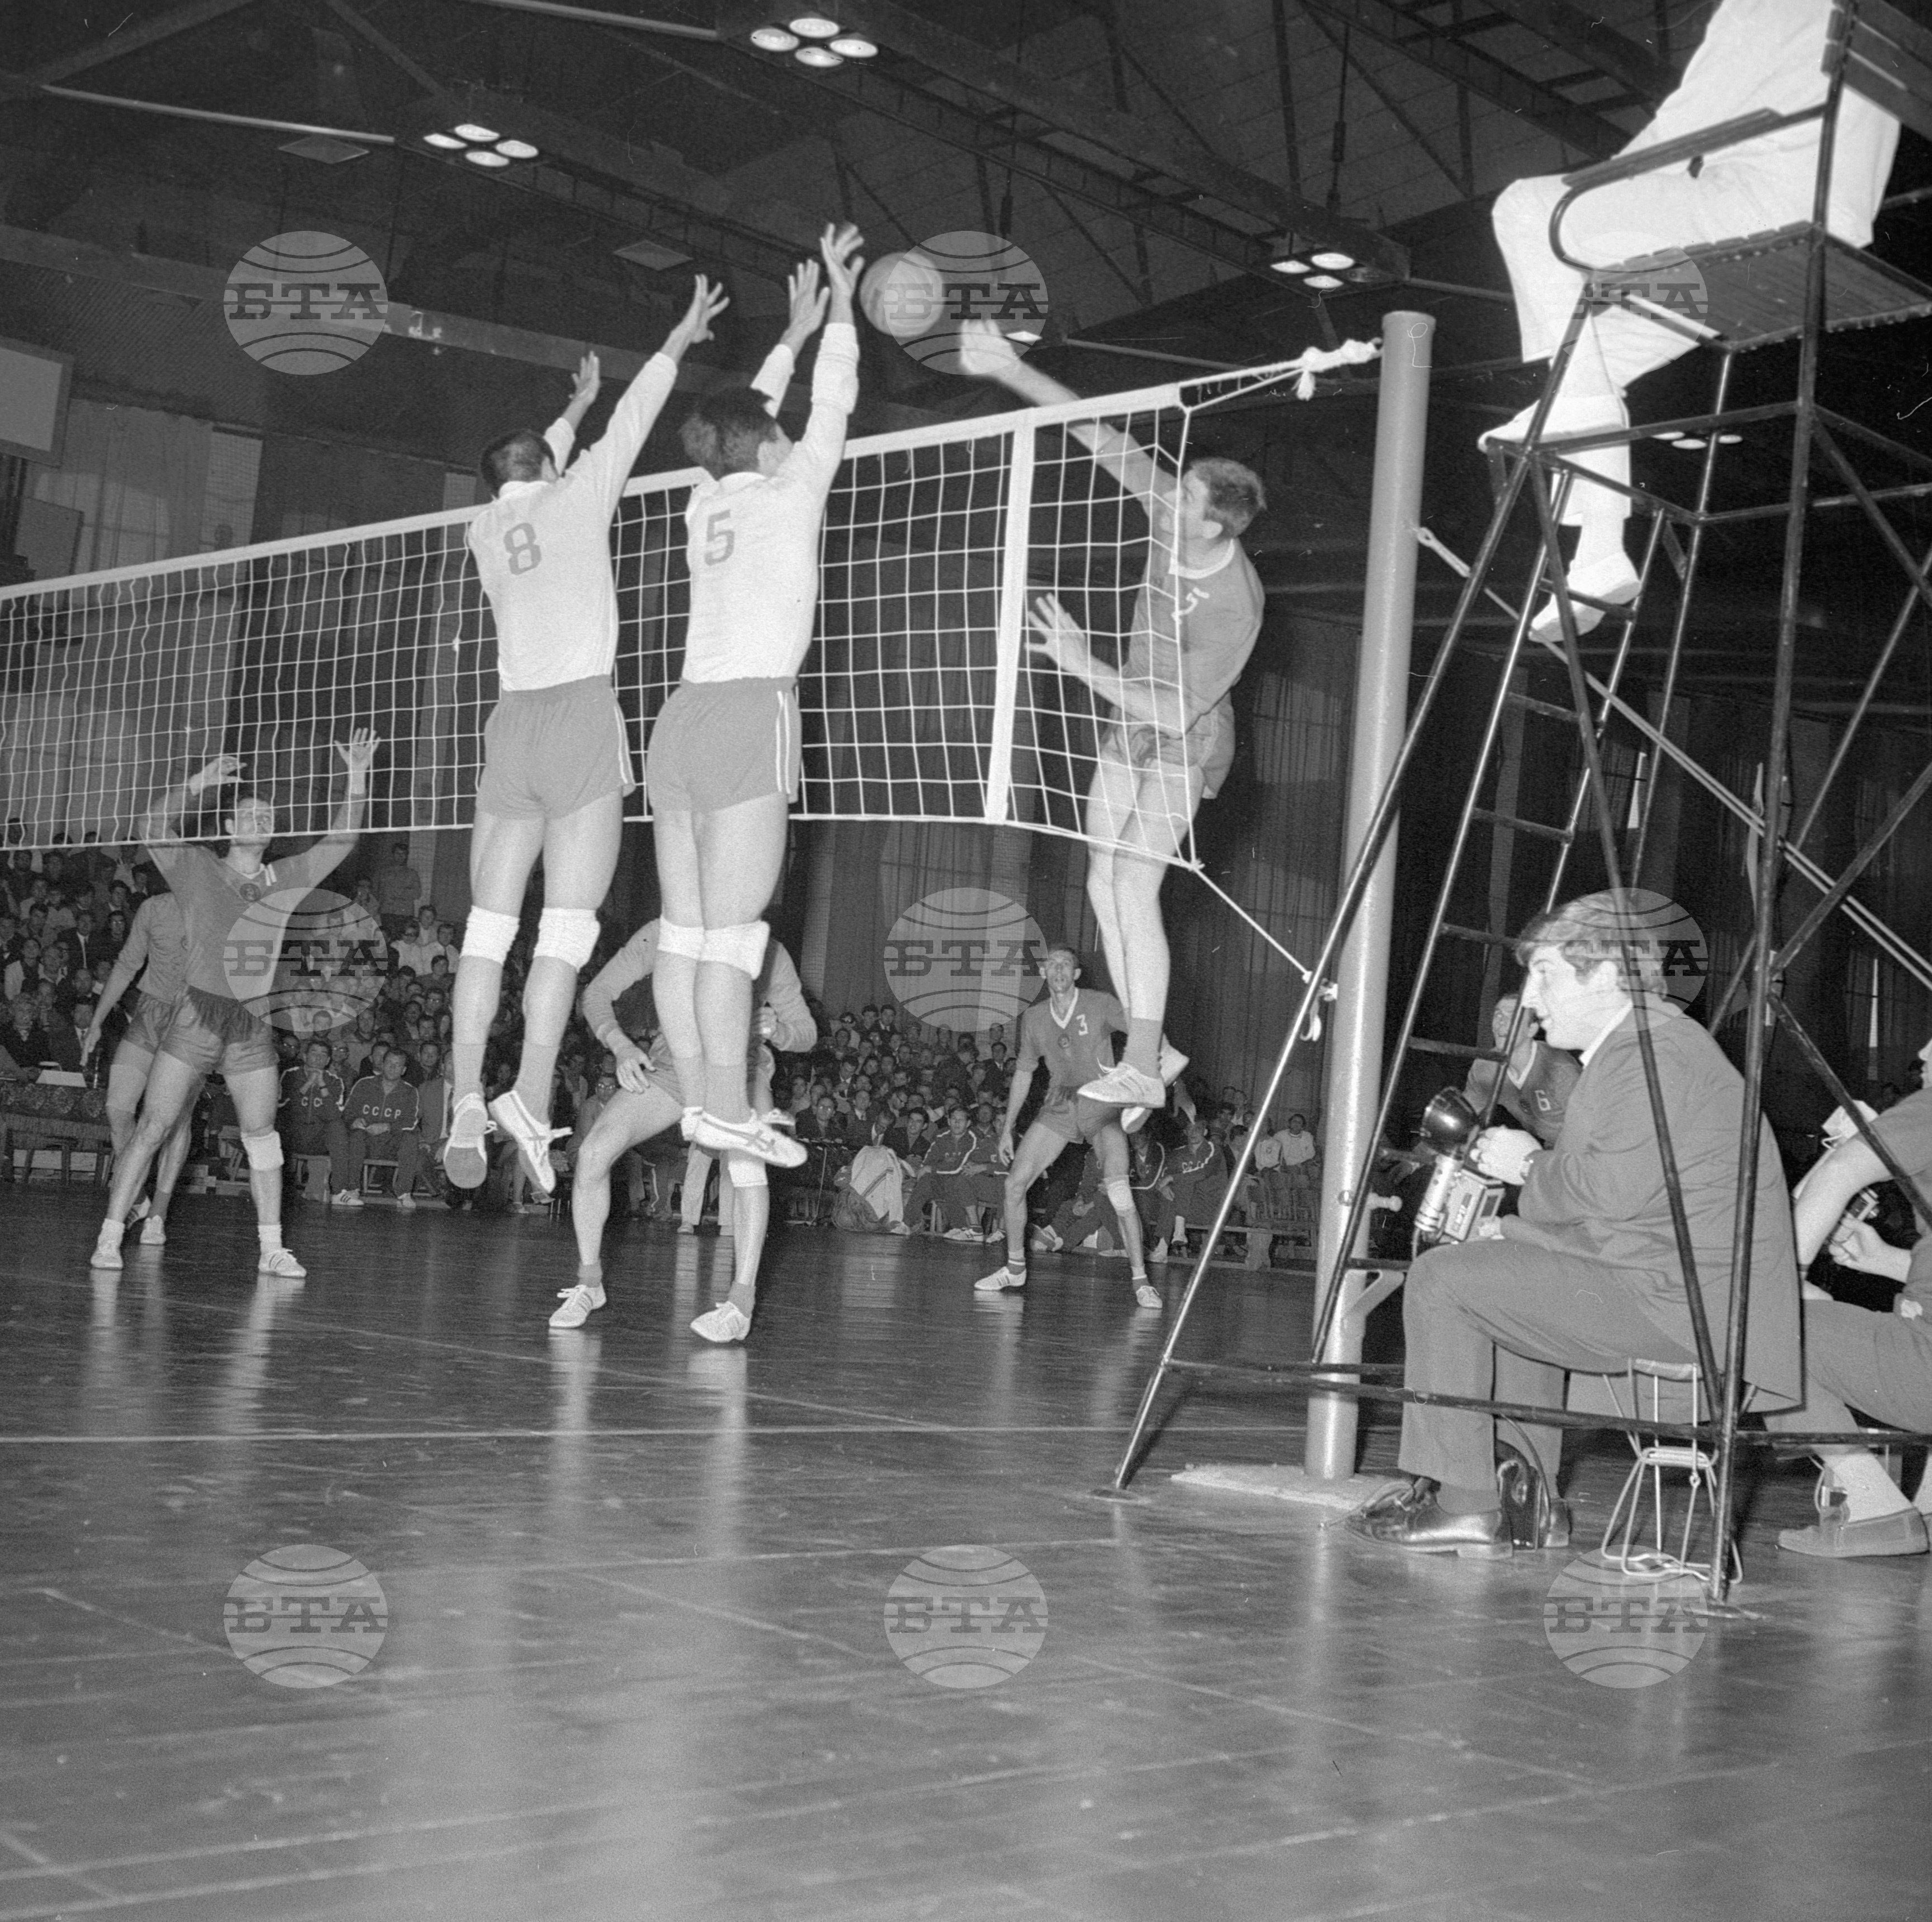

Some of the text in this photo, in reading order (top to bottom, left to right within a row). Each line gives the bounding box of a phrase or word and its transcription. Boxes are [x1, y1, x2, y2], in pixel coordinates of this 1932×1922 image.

[704, 509, 735, 566] 5
[503, 523, 542, 575] 8
[1076, 1014, 1088, 1036] 3
[1535, 1089, 1551, 1111] 6
[363, 1104, 401, 1119] СССР
